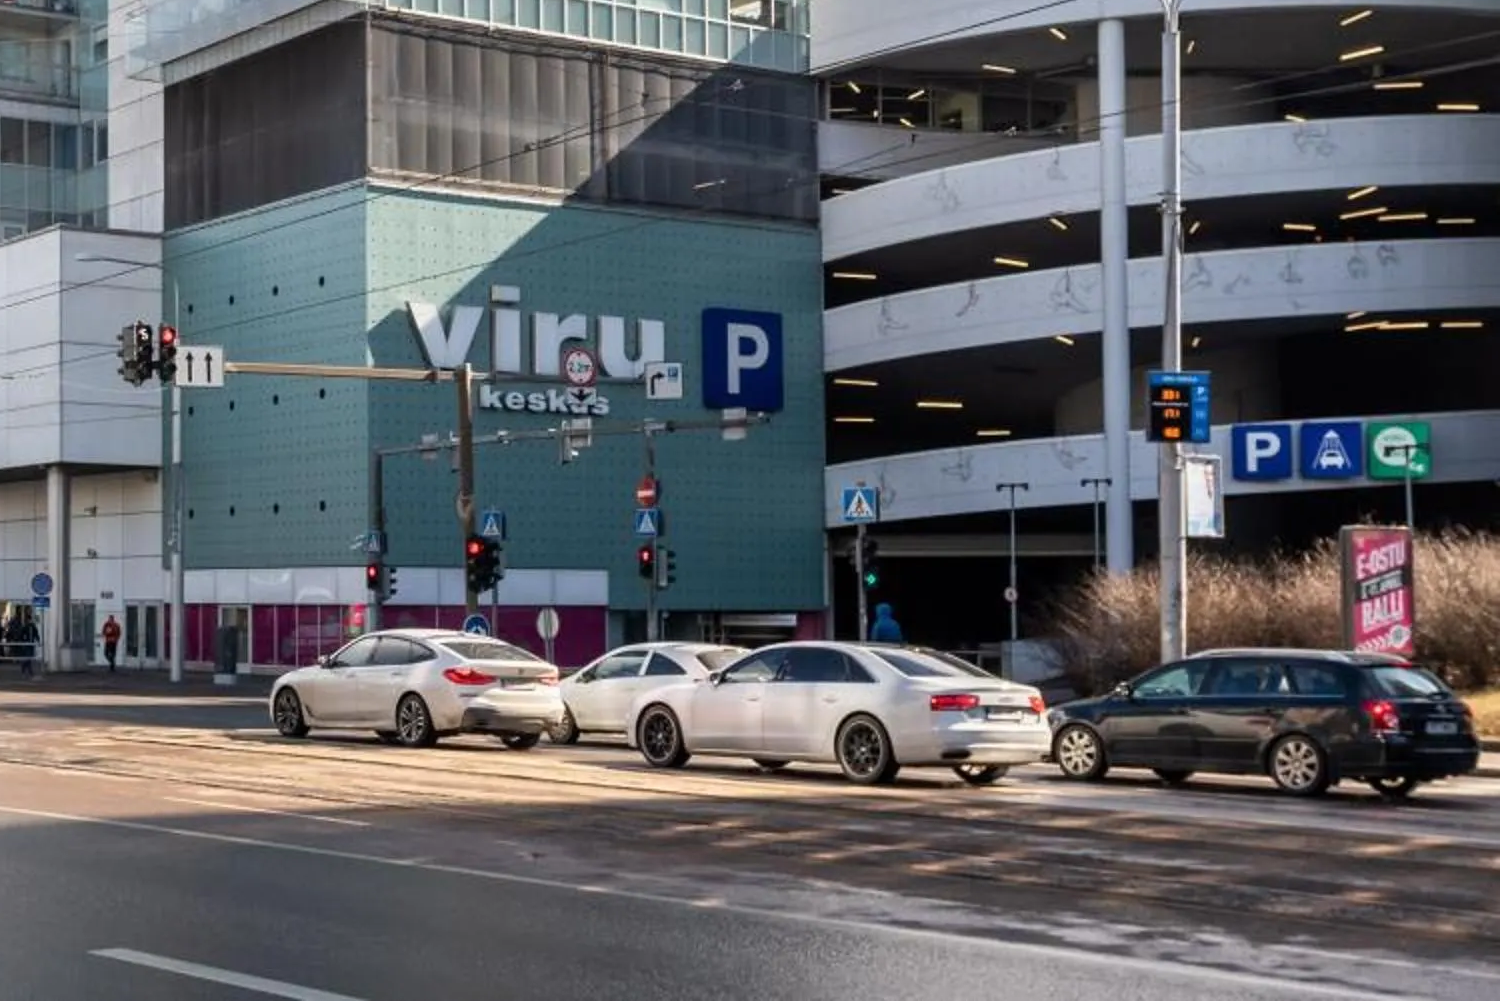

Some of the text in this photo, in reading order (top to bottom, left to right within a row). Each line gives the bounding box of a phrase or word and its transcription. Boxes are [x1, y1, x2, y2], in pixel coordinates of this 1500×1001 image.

[405, 285, 666, 379] viru
[727, 323, 770, 395] P
[1246, 431, 1281, 472] P
